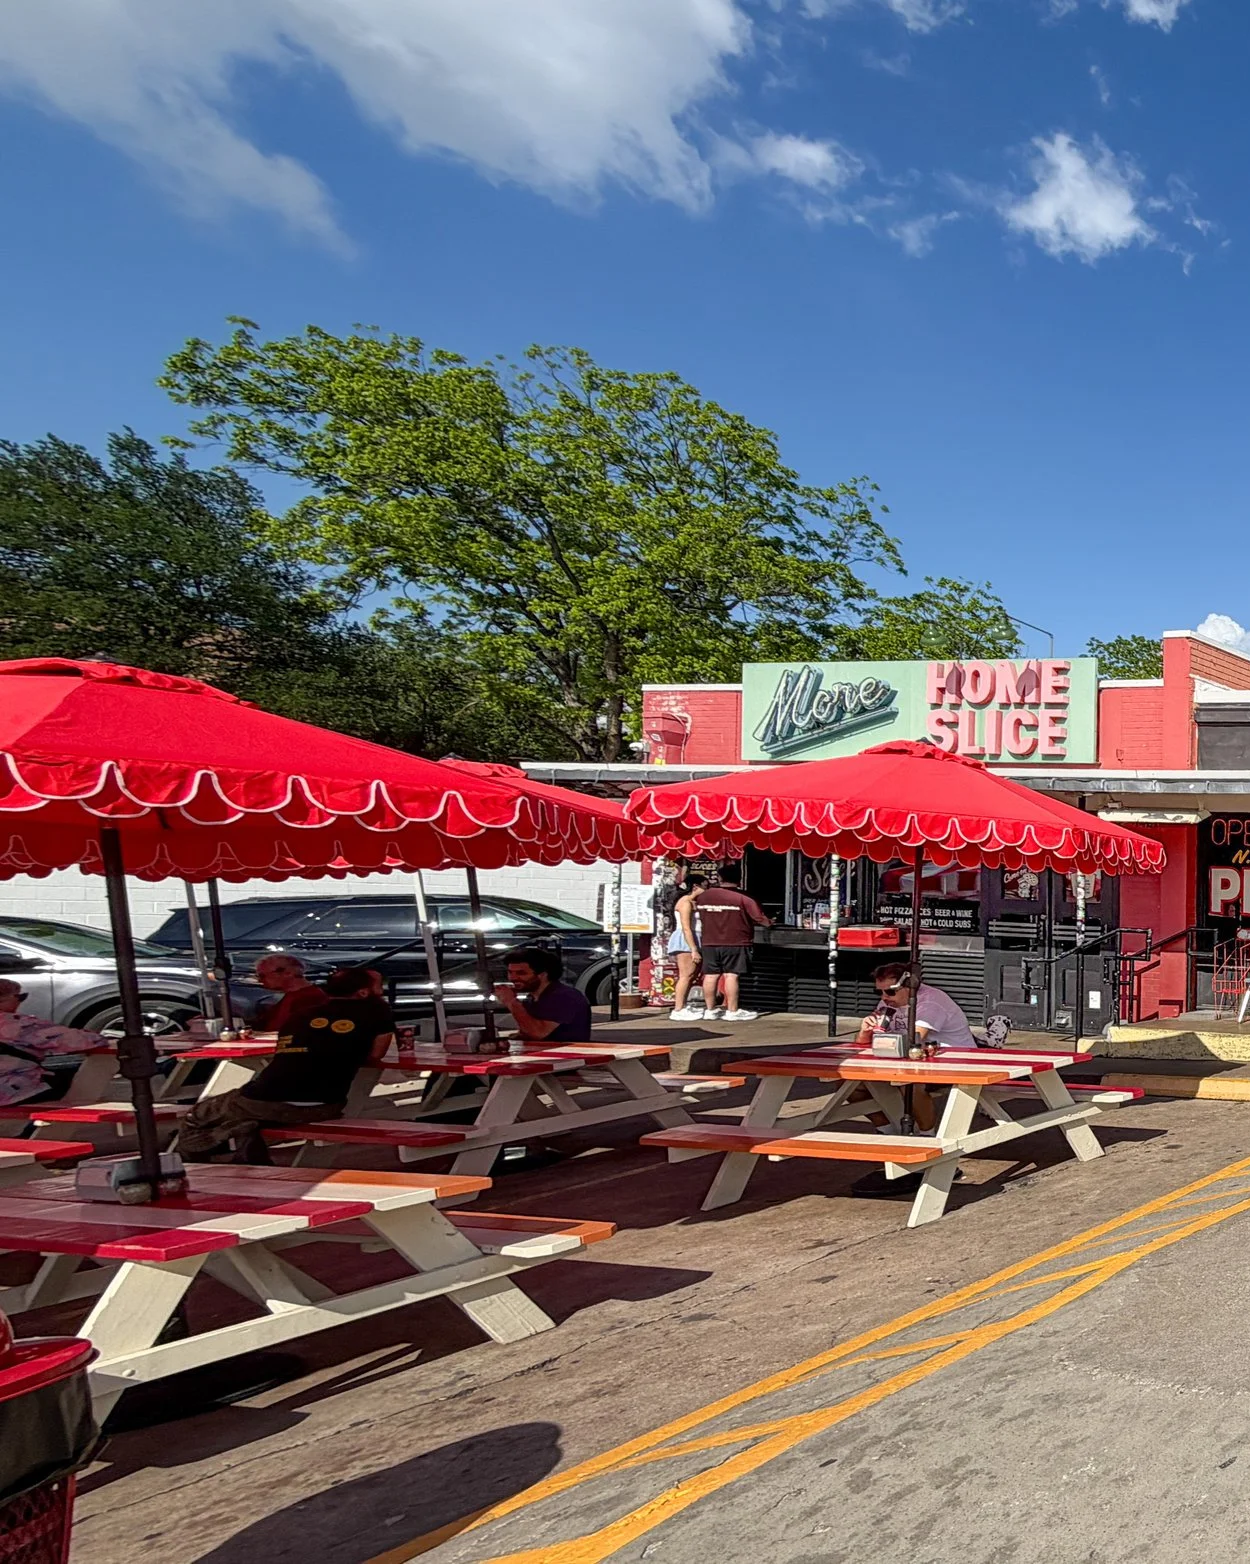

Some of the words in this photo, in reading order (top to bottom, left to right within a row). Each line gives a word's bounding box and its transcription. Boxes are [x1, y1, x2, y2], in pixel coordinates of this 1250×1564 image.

[752, 664, 890, 743] More
[926, 660, 1071, 706] HOME
[926, 709, 1068, 756] SLICE
[880, 906, 893, 915] HOT
[893, 906, 913, 915] PIZZA
[893, 917, 913, 926] SALAD
[937, 919, 954, 928] COLD
[954, 919, 972, 928] SUBS
